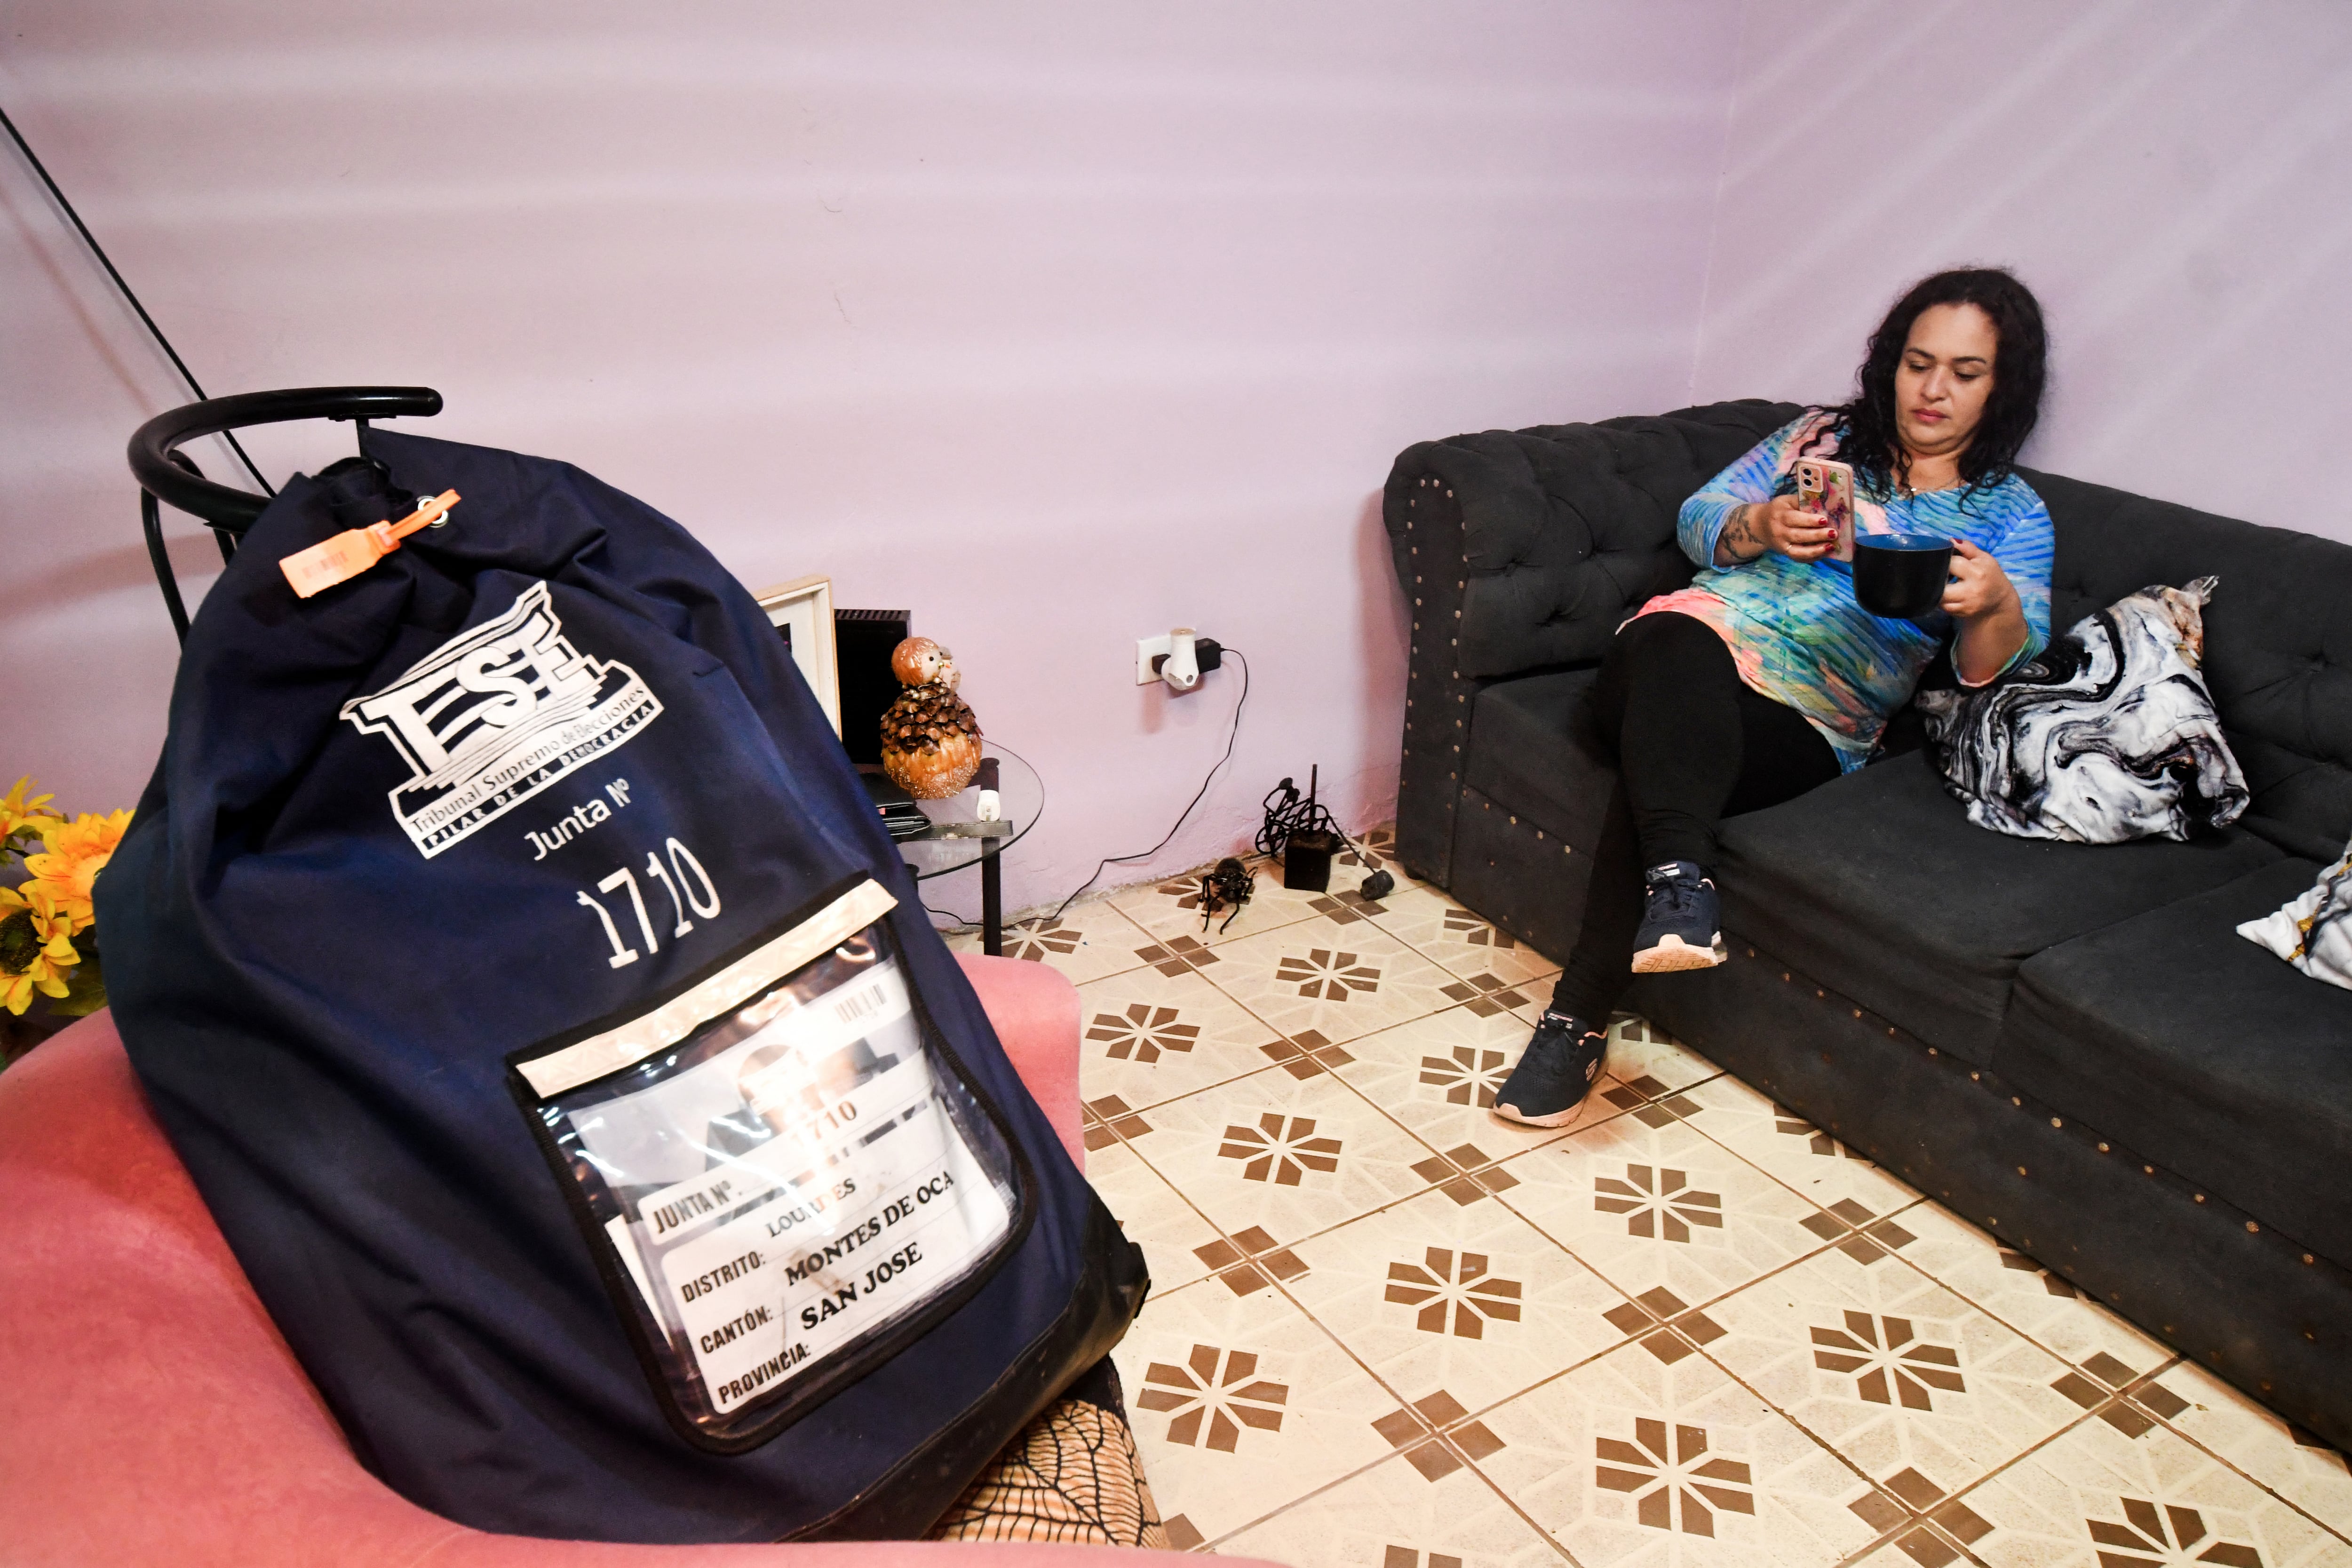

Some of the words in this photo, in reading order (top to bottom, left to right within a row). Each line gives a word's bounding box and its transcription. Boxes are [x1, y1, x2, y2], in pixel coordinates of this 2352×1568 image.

[360, 611, 596, 772] TSE
[410, 784, 482, 833] Tribunal
[483, 740, 560, 790] Supremo
[561, 731, 577, 744] de
[573, 686, 644, 738] Elecciones
[427, 808, 487, 846] PILAR
[493, 787, 519, 806] DE
[527, 769, 553, 786] LA
[558, 705, 653, 767] DEMOCRACIA
[524, 799, 611, 860] Junta
[577, 837, 721, 969] 1710
[652, 1192, 715, 1234] JUNTA
[681, 1250, 766, 1303] DISTRITO:
[700, 1305, 773, 1354] CANTÓN:
[784, 1217, 881, 1286] MONTES
[883, 1195, 915, 1227] DE
[917, 1170, 955, 1204] OCA
[718, 1342, 811, 1404] PROVINCIA:
[801, 1283, 858, 1330] SAN
[864, 1241, 923, 1294] JOSE
